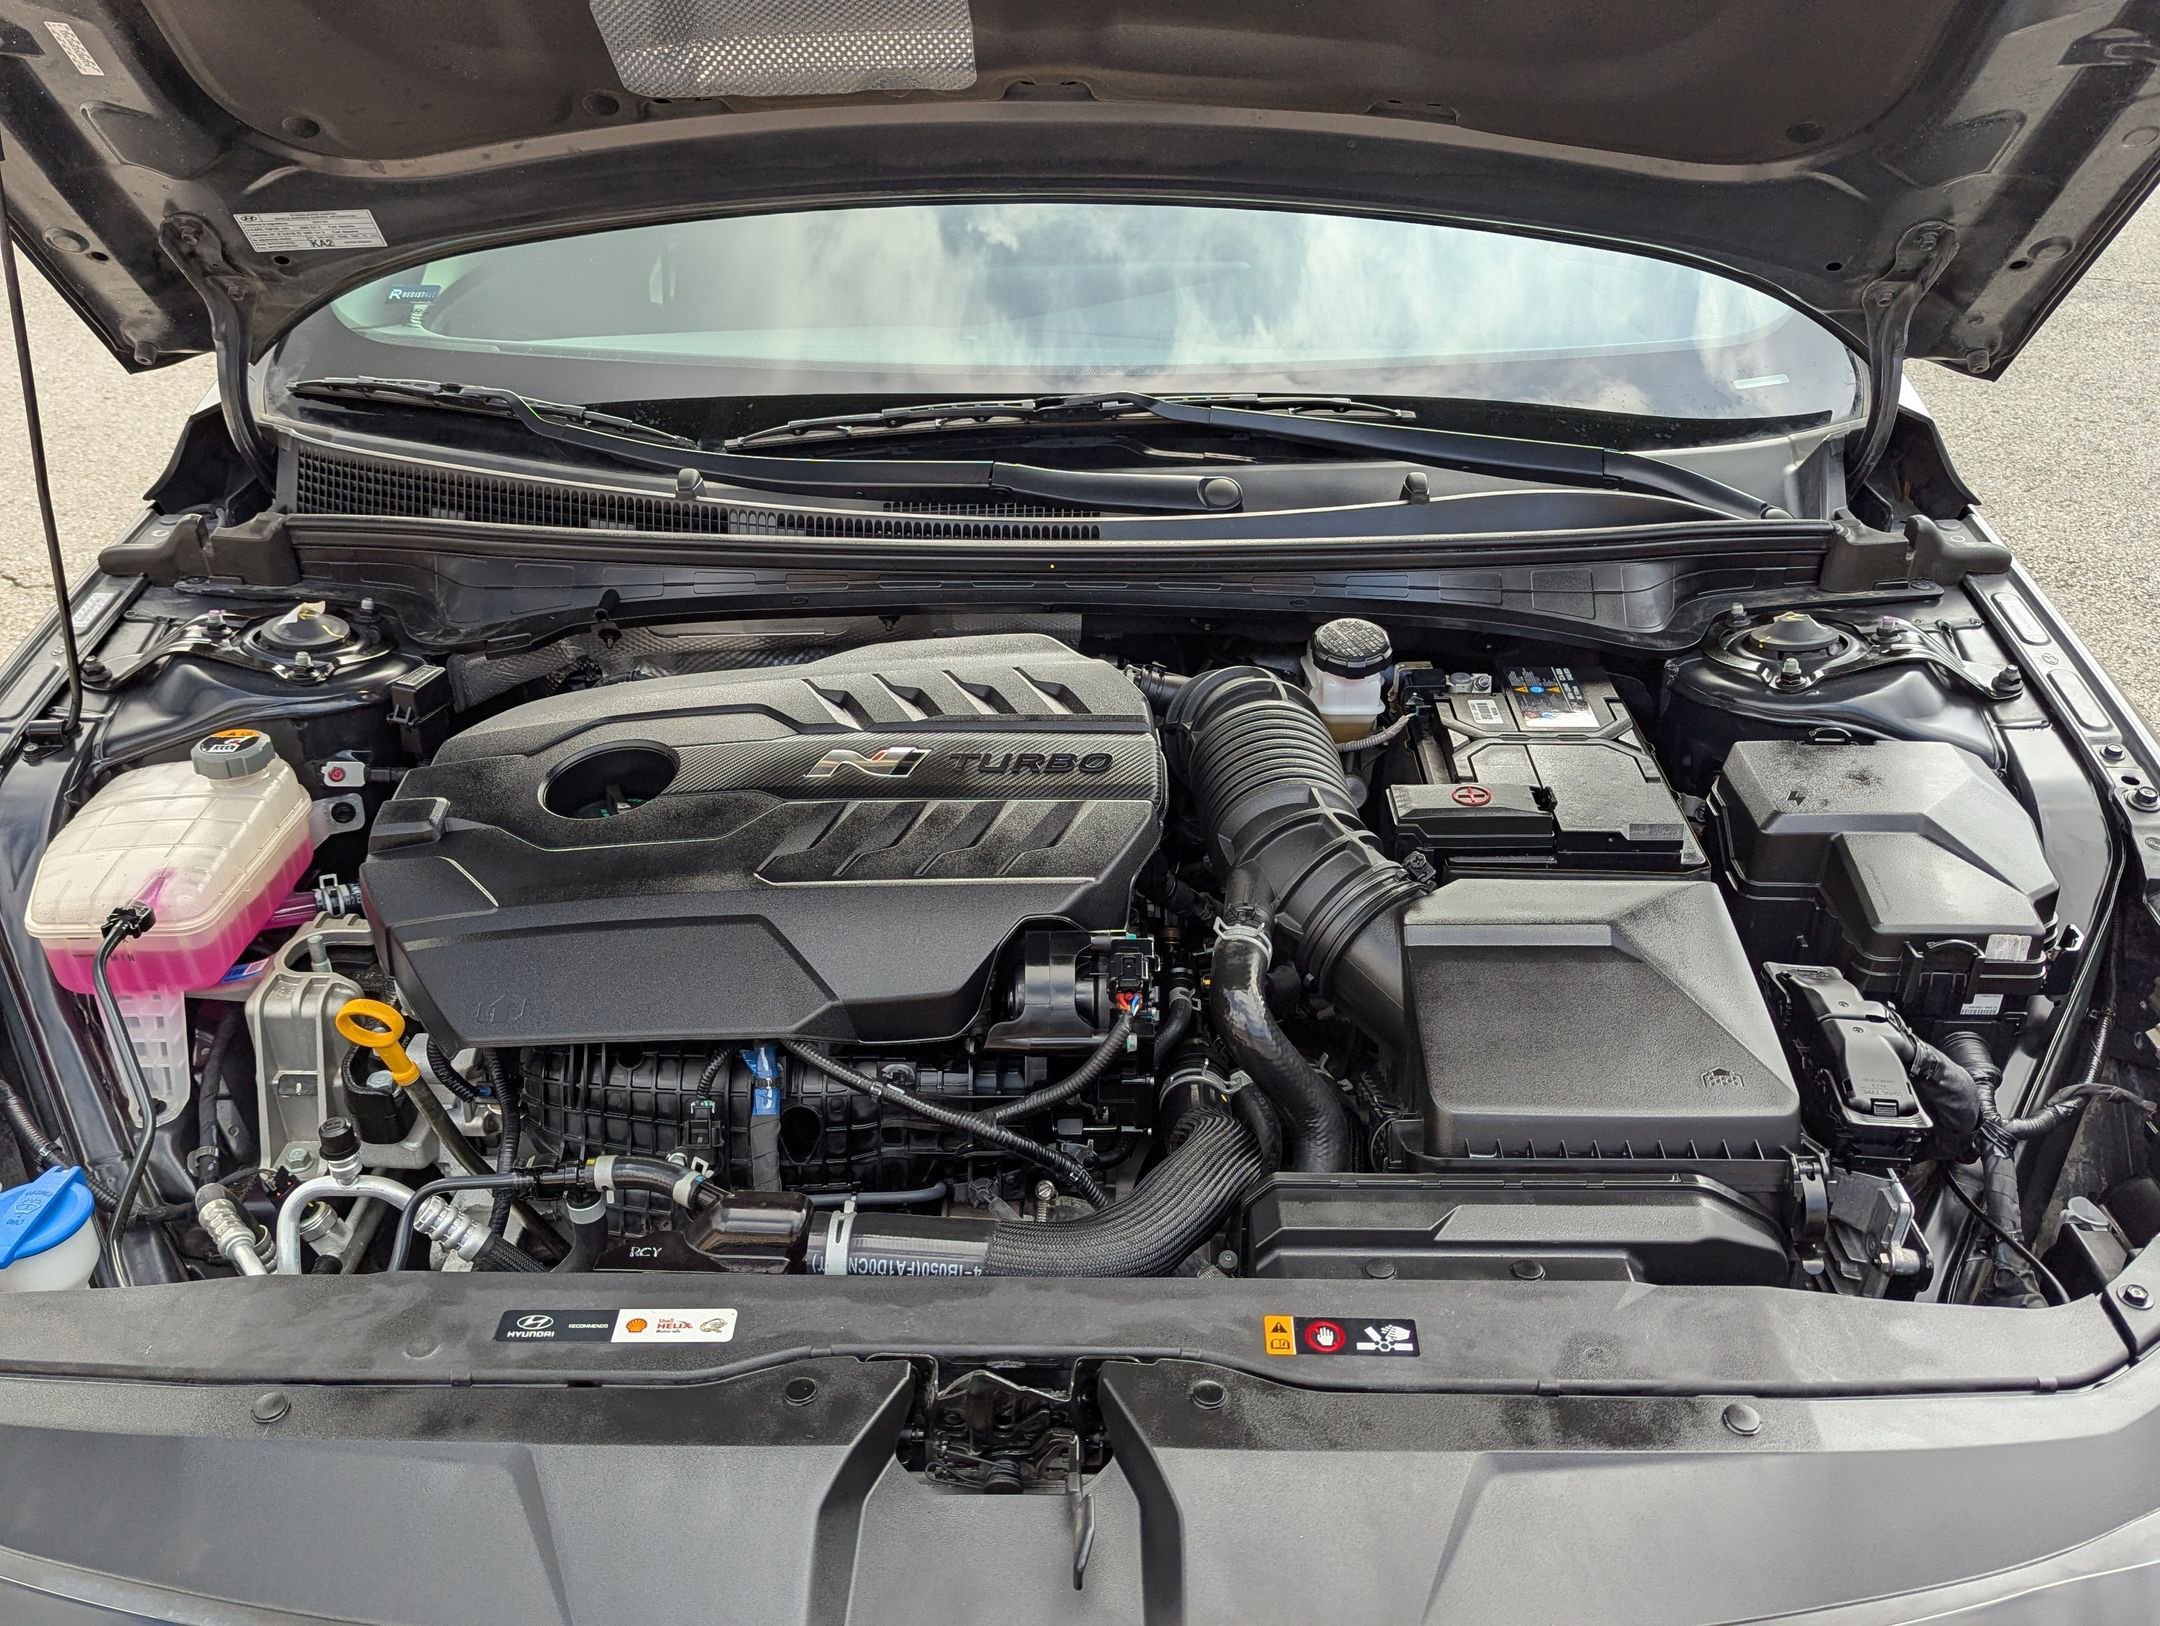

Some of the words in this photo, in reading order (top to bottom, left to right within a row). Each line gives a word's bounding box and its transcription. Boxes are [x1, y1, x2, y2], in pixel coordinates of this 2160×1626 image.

[311, 239, 335, 248] KA2
[950, 752, 1114, 774] TURBO
[110, 953, 136, 962] MIN
[629, 1246, 663, 1258] RCY
[657, 1320, 693, 1329] HELIX
